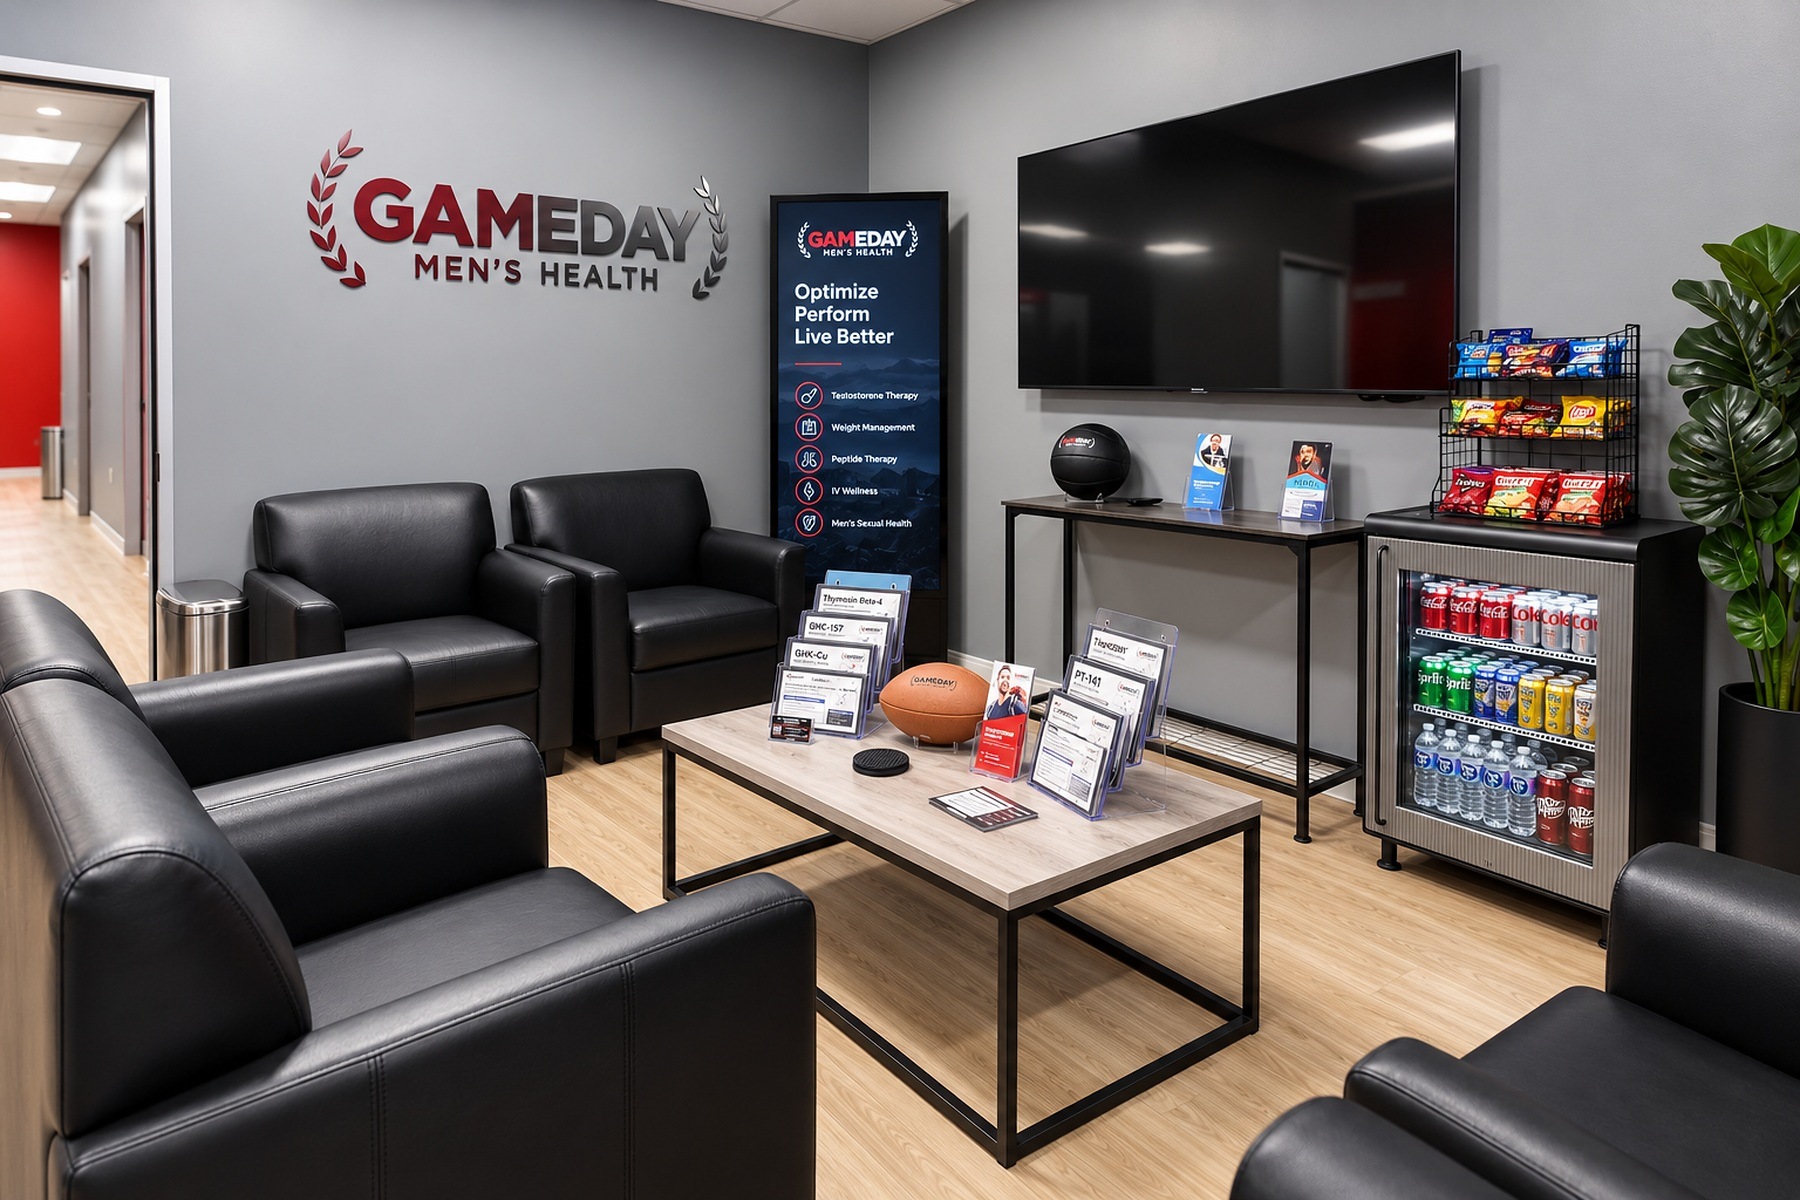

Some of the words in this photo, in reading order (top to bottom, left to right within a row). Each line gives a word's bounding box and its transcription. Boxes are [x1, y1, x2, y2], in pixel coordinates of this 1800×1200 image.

[354, 177, 701, 262] GAMEDAY
[808, 230, 907, 248] GAMEDAY
[856, 248, 893, 257] HEALTH
[414, 253, 522, 284] MEN'S
[540, 261, 659, 292] HEALTH
[795, 283, 879, 304] Optimize
[795, 305, 870, 322] Perform
[795, 328, 832, 345] Live
[837, 328, 894, 345] Better
[885, 391, 919, 401] Therapy
[831, 423, 861, 433] Weight
[862, 423, 916, 433] Management
[831, 454, 863, 465] Peptide
[864, 454, 898, 465] Therapy
[831, 487, 841, 495] IV
[842, 486, 879, 496] Wellness
[831, 519, 856, 528] Men's
[856, 519, 884, 528] Sexual
[885, 519, 913, 528] Health
[1074, 669, 1102, 688] PT-141
